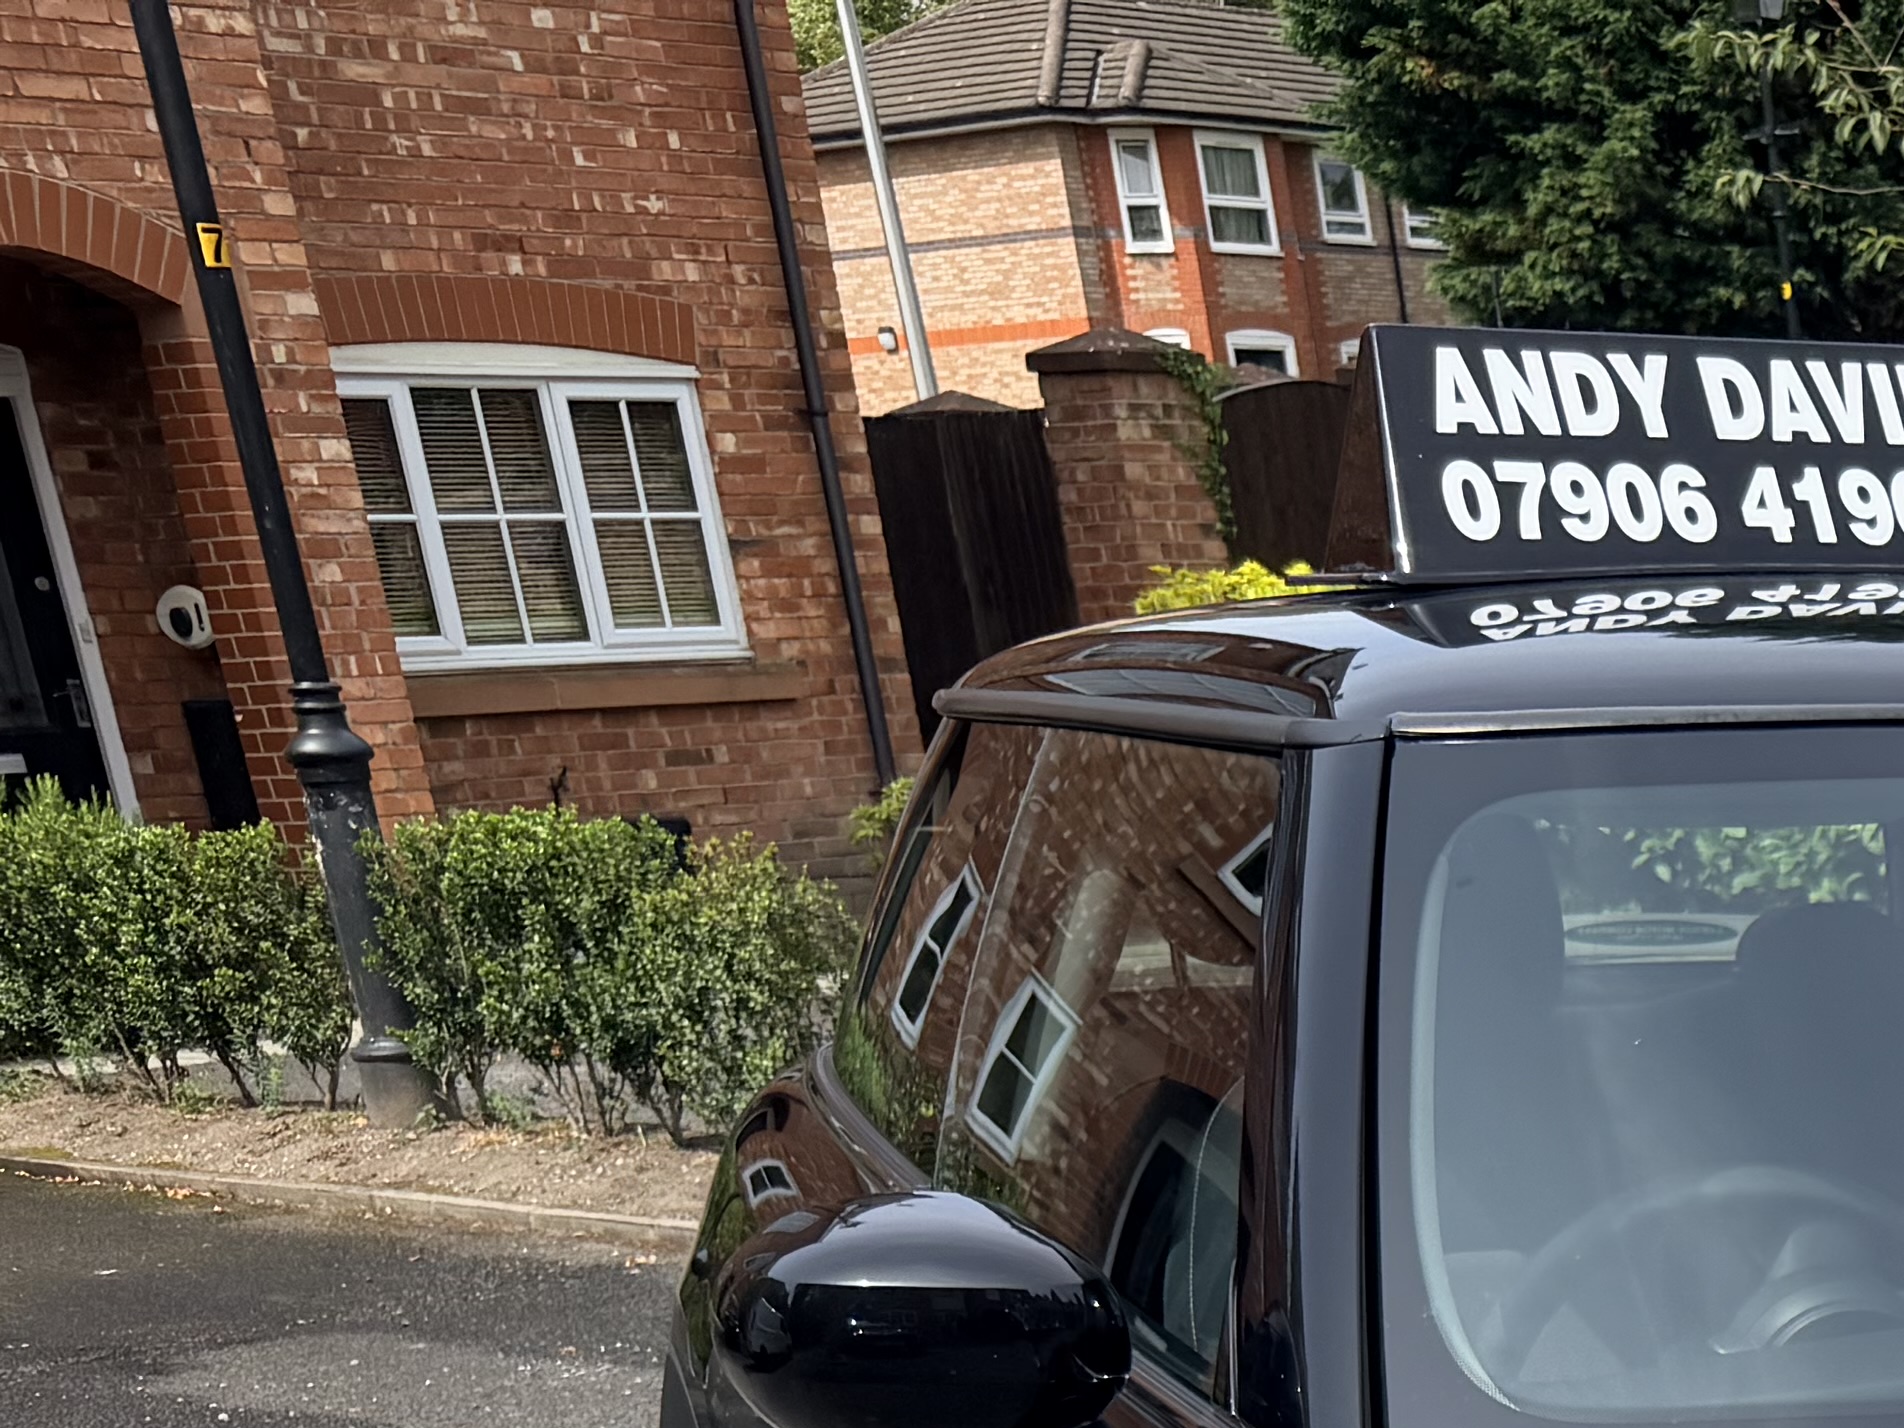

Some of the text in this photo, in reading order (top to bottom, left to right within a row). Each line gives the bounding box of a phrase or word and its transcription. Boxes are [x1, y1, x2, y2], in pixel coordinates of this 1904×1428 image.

[201, 226, 222, 264] 7
[1434, 345, 1670, 440] ANDY
[1440, 459, 1719, 544] 07906
